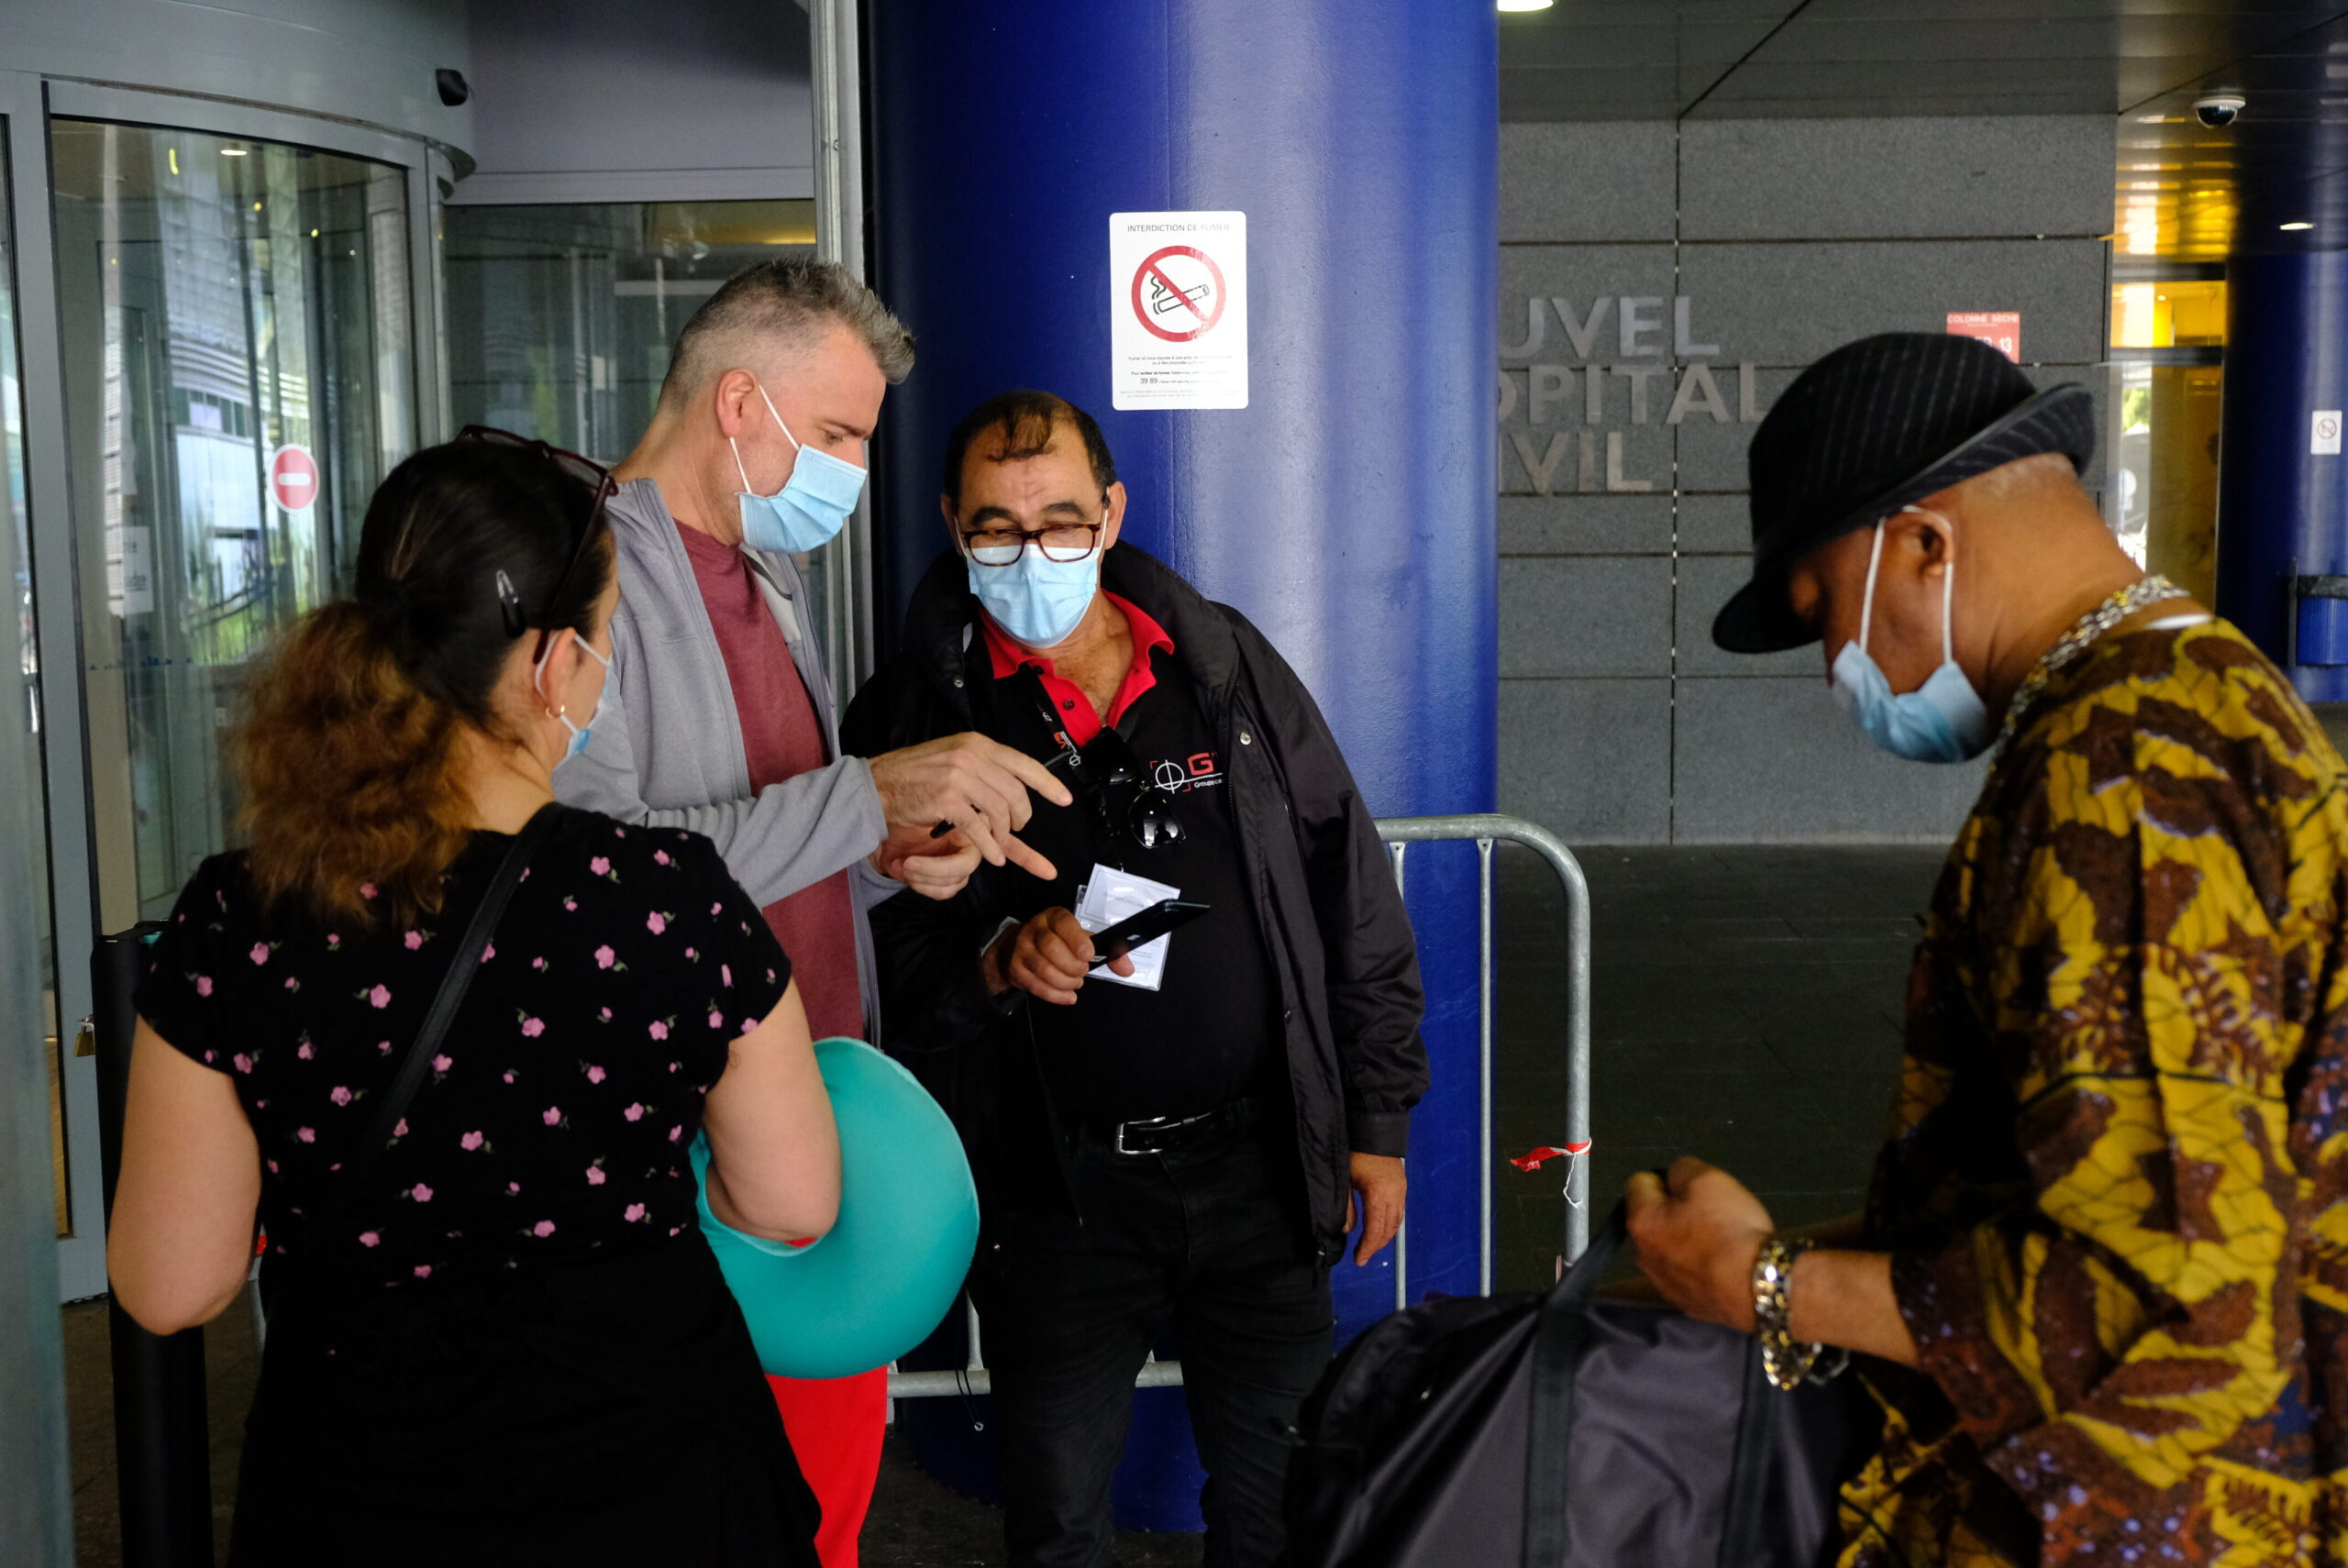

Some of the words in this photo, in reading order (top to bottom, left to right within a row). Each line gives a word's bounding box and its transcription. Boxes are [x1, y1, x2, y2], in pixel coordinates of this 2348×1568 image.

[1127, 224, 1185, 232] INTERDICTION
[1187, 223, 1198, 231] DE
[1499, 296, 1720, 359] UVEL
[1499, 431, 1652, 495] VIL
[1187, 750, 1217, 776] G
